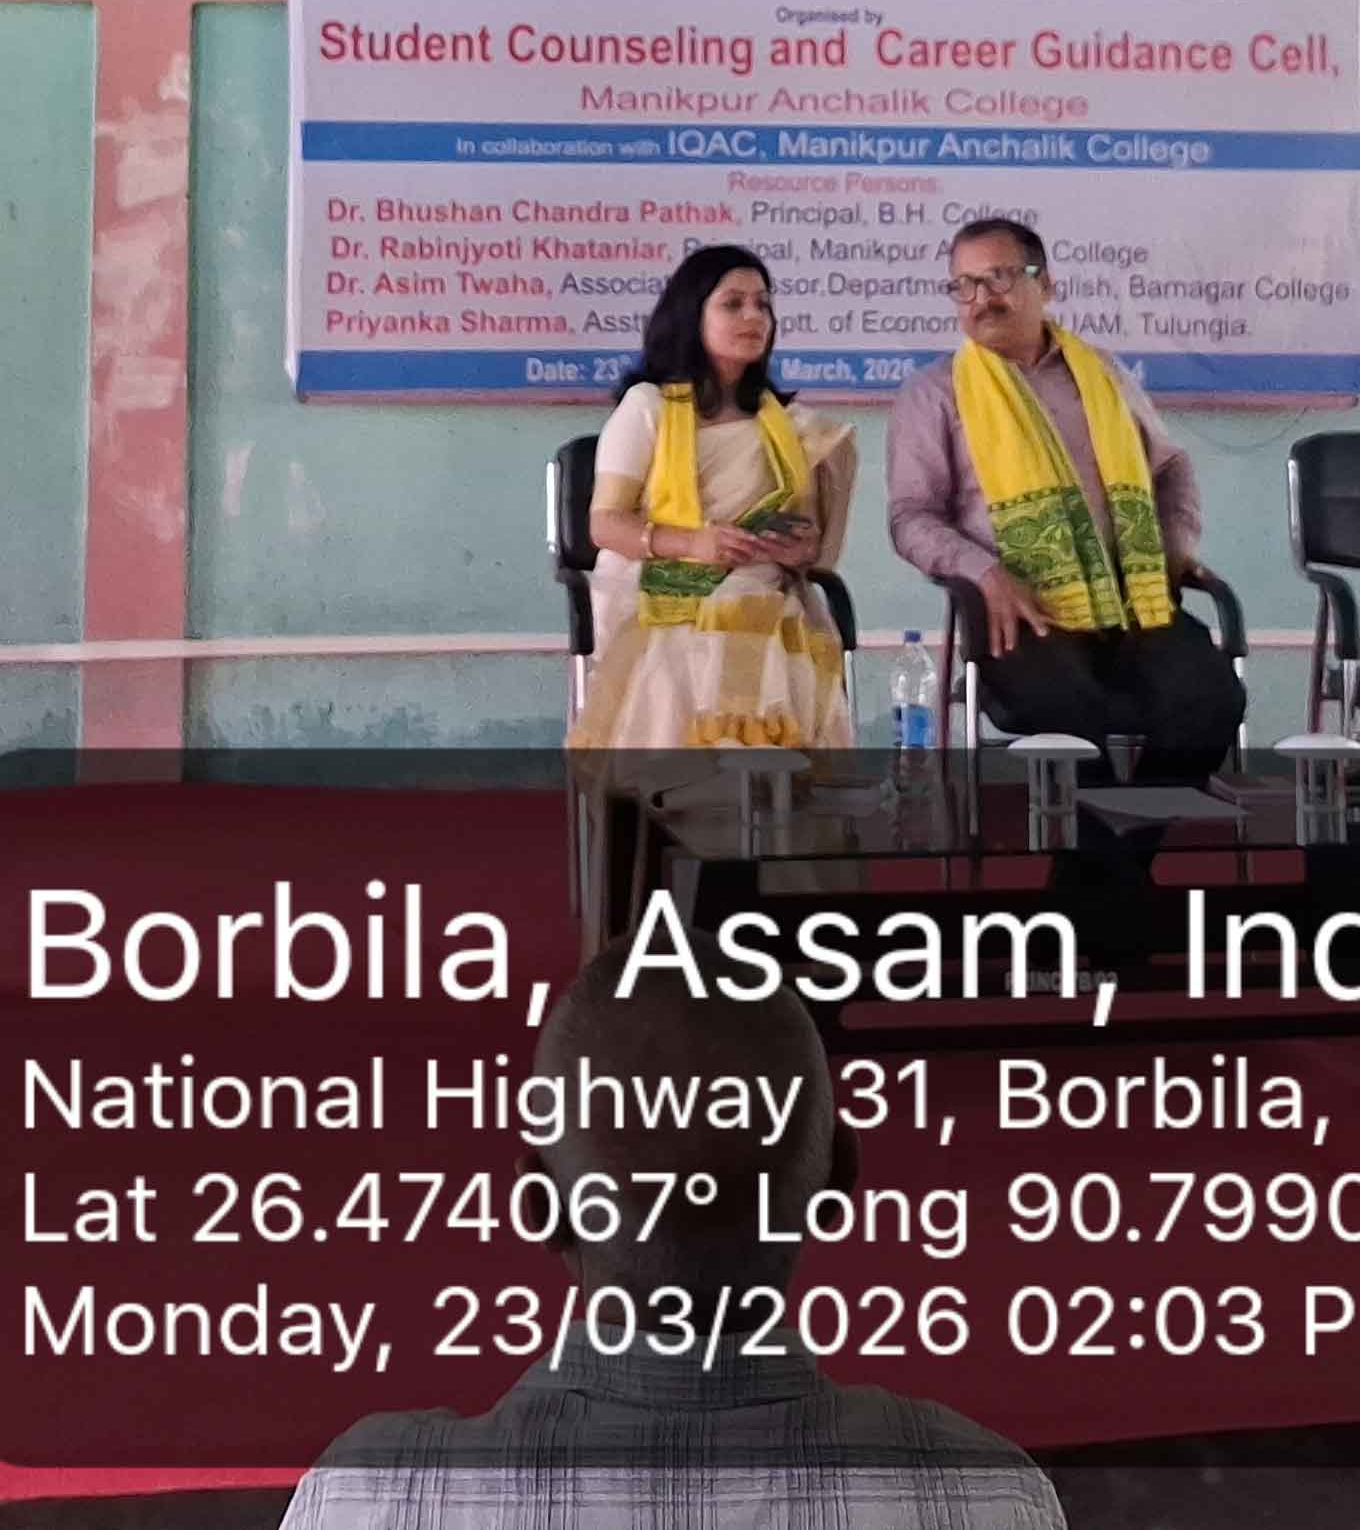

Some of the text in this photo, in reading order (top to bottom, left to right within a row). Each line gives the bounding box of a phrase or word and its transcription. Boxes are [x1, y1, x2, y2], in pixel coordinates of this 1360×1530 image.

[864, 8, 884, 28] by
[320, 21, 1341, 78] Student Counseling and Career Guidance Cell,
[581, 84, 1090, 120] Manikpur Anchalik College
[455, 129, 1211, 167] In collaboration with IQAC, Manikpur Anchalik College
[727, 170, 839, 192] Resource
[327, 198, 366, 223] Dr.
[376, 198, 502, 223] Bhushan
[511, 200, 630, 223] Chandra
[640, 201, 740, 226] Pathak,
[751, 200, 869, 229] Principal,
[331, 236, 369, 261] Dr.
[379, 236, 523, 265] Rabinjyoti
[533, 236, 672, 263] Khataniar,
[810, 238, 926, 265] Manikpur
[1052, 239, 1149, 268] College
[326, 271, 366, 295] Dr.
[374, 271, 446, 295] Asim
[457, 271, 554, 299] Twaha,
[1255, 277, 1351, 304] College
[326, 310, 451, 338] Priyanka
[829, 309, 854, 333] of
